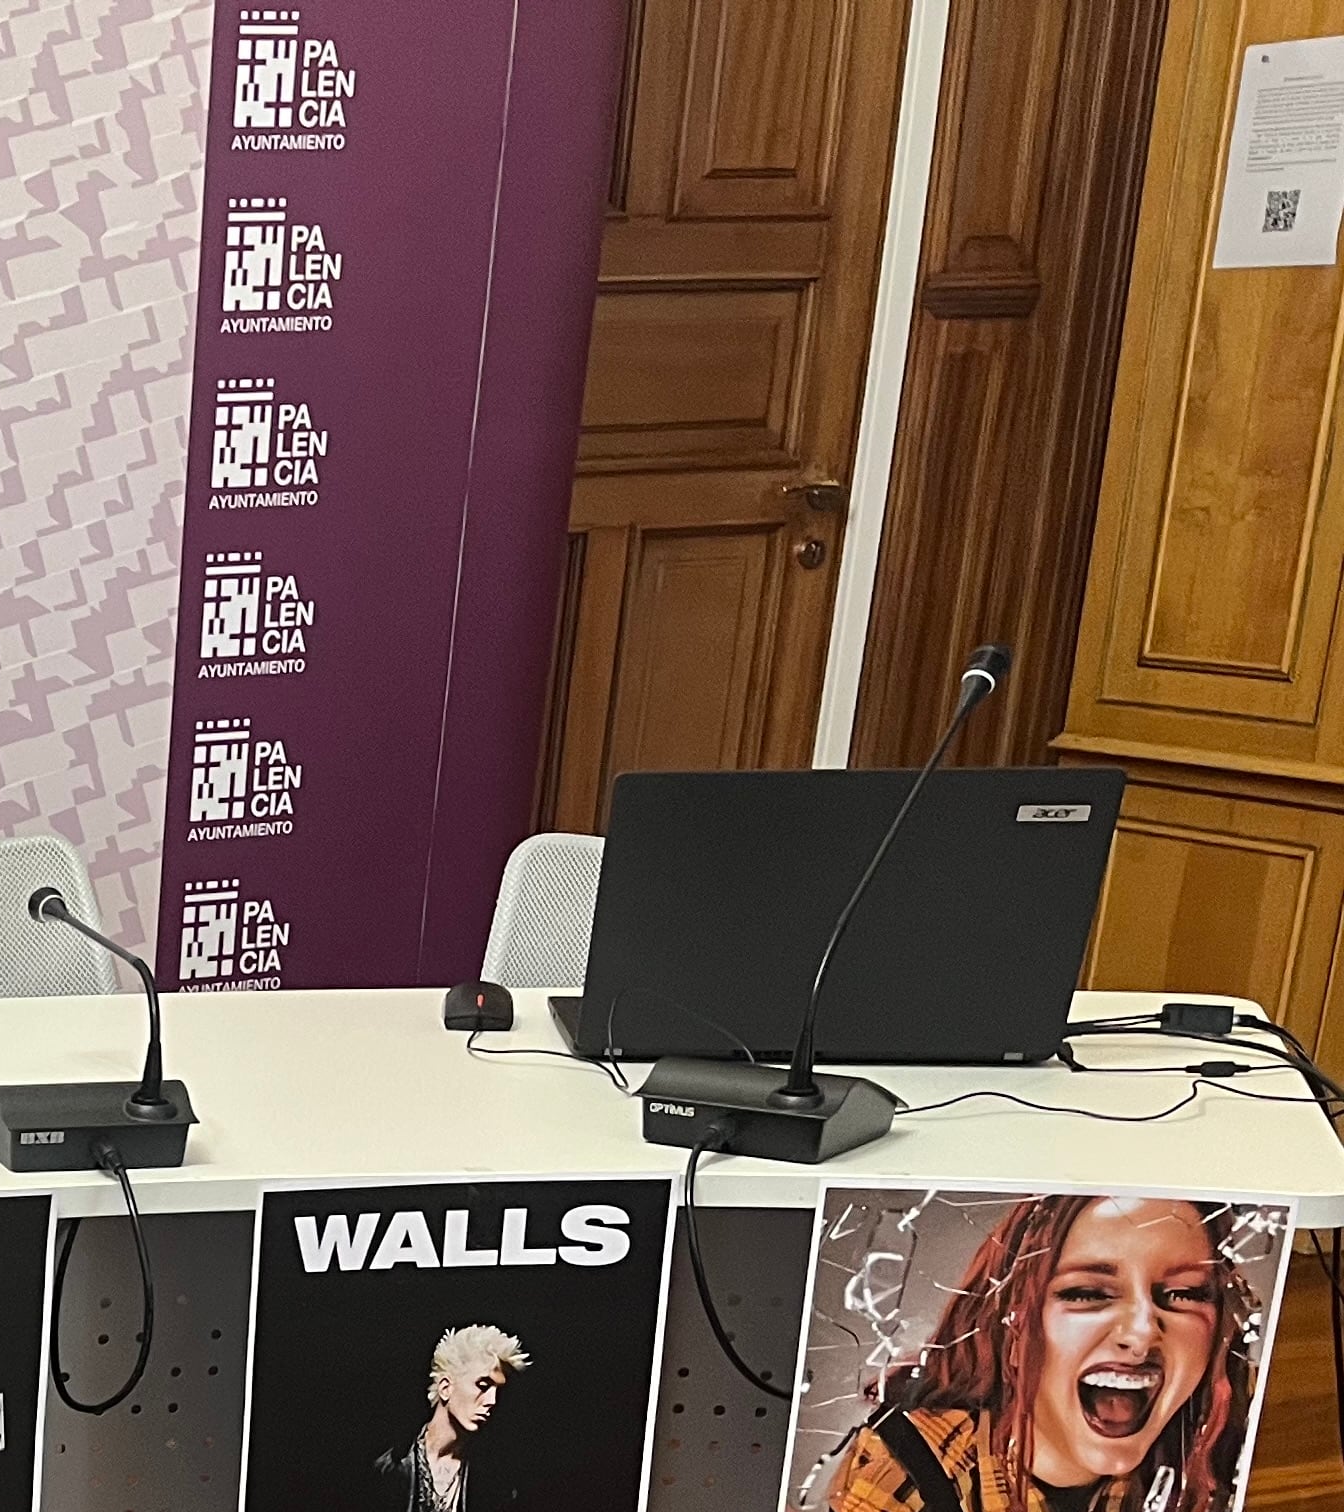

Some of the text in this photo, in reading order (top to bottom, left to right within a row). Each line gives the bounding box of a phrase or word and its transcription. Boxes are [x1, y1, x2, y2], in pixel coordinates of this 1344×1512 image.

[303, 39, 338, 68] PA
[301, 70, 356, 98] LEN
[299, 100, 346, 128] CIA
[231, 134, 345, 151] AYUNTAMIENTO
[291, 225, 325, 252] PA
[289, 253, 342, 281] LEN
[286, 282, 333, 310] CIA
[220, 315, 333, 334] AYUNTAMIENTO
[278, 403, 312, 430] PA
[276, 430, 328, 458] LEN
[273, 459, 319, 486] CIA
[208, 490, 318, 510] AYUNTAMIENTO
[266, 575, 299, 601] PA
[264, 600, 314, 628] LEN
[262, 628, 306, 655] CIA
[198, 658, 306, 679] AYUNTAMIENTO
[254, 740, 287, 766] PA
[253, 764, 302, 792] LEN
[250, 791, 294, 818] CIA
[1032, 808, 1077, 819] acer
[187, 820, 293, 842] AYUNTAMIENTO
[242, 900, 275, 924] PA
[241, 922, 290, 950] LEN
[239, 948, 282, 974] CIA
[293, 1204, 630, 1273] WALLS
